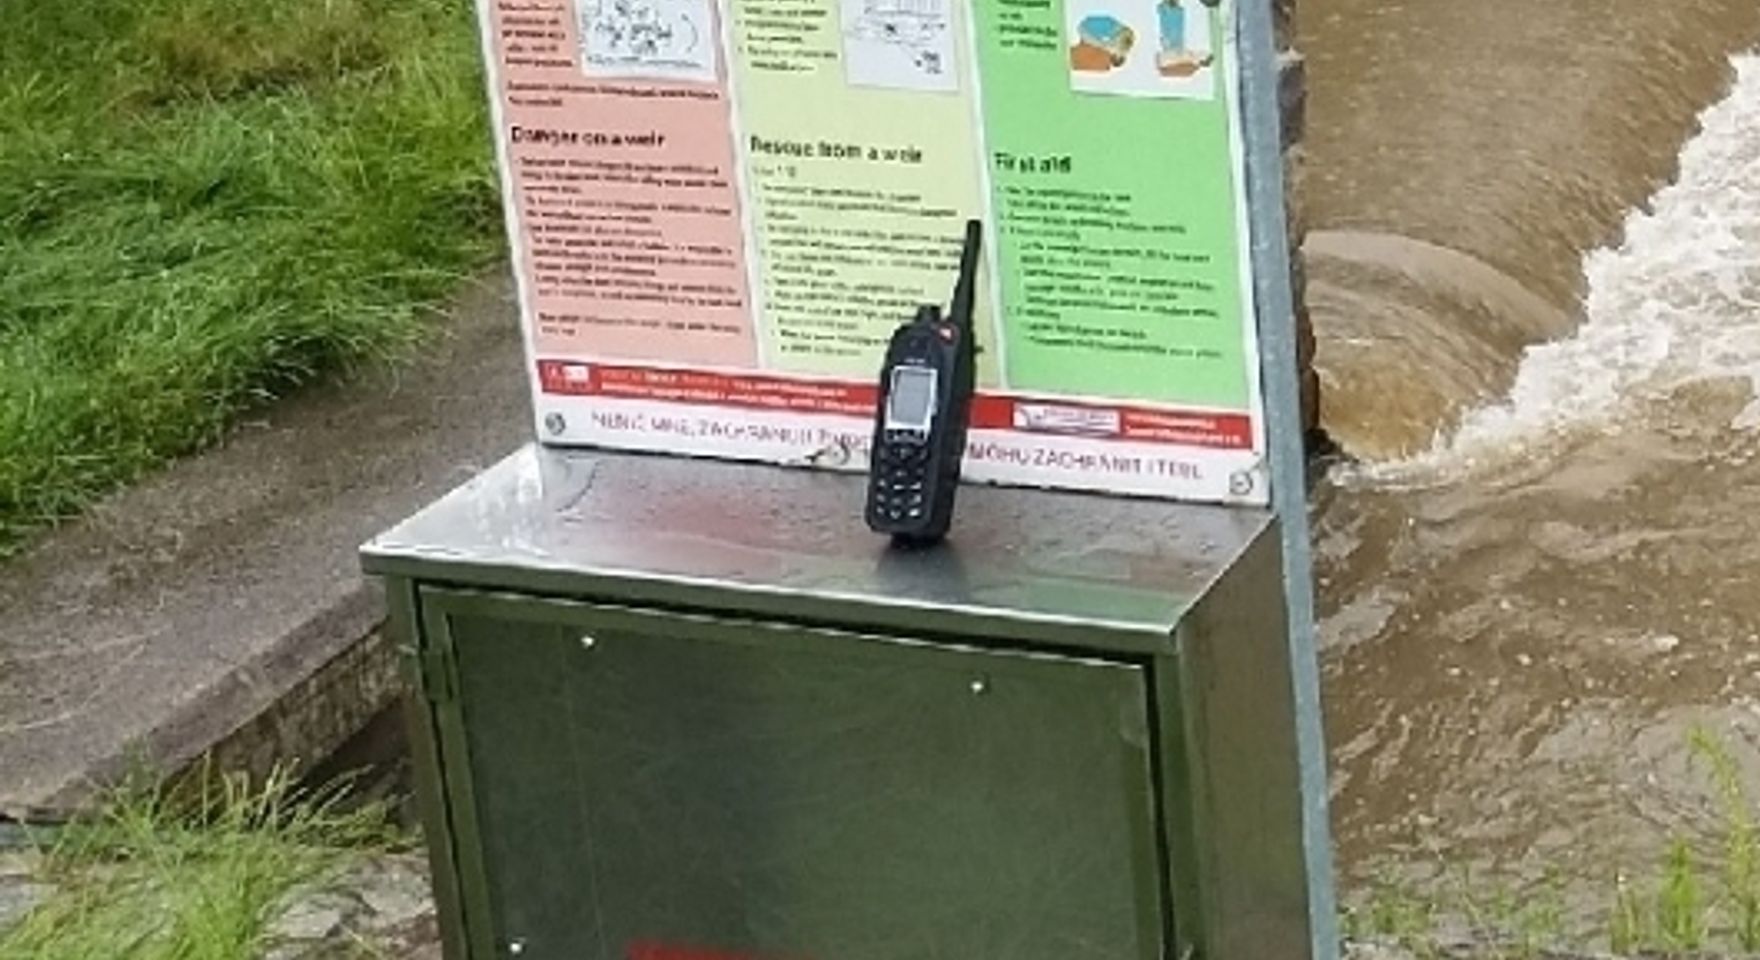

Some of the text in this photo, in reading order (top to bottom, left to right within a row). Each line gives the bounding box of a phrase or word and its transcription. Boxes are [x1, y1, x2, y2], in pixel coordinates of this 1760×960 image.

[511, 125, 578, 147] Danger
[582, 131, 607, 146] on
[624, 130, 666, 147] weir
[750, 135, 814, 158] Rescue
[818, 141, 862, 160] from
[867, 147, 879, 161] a
[995, 152, 1072, 174] First aid
